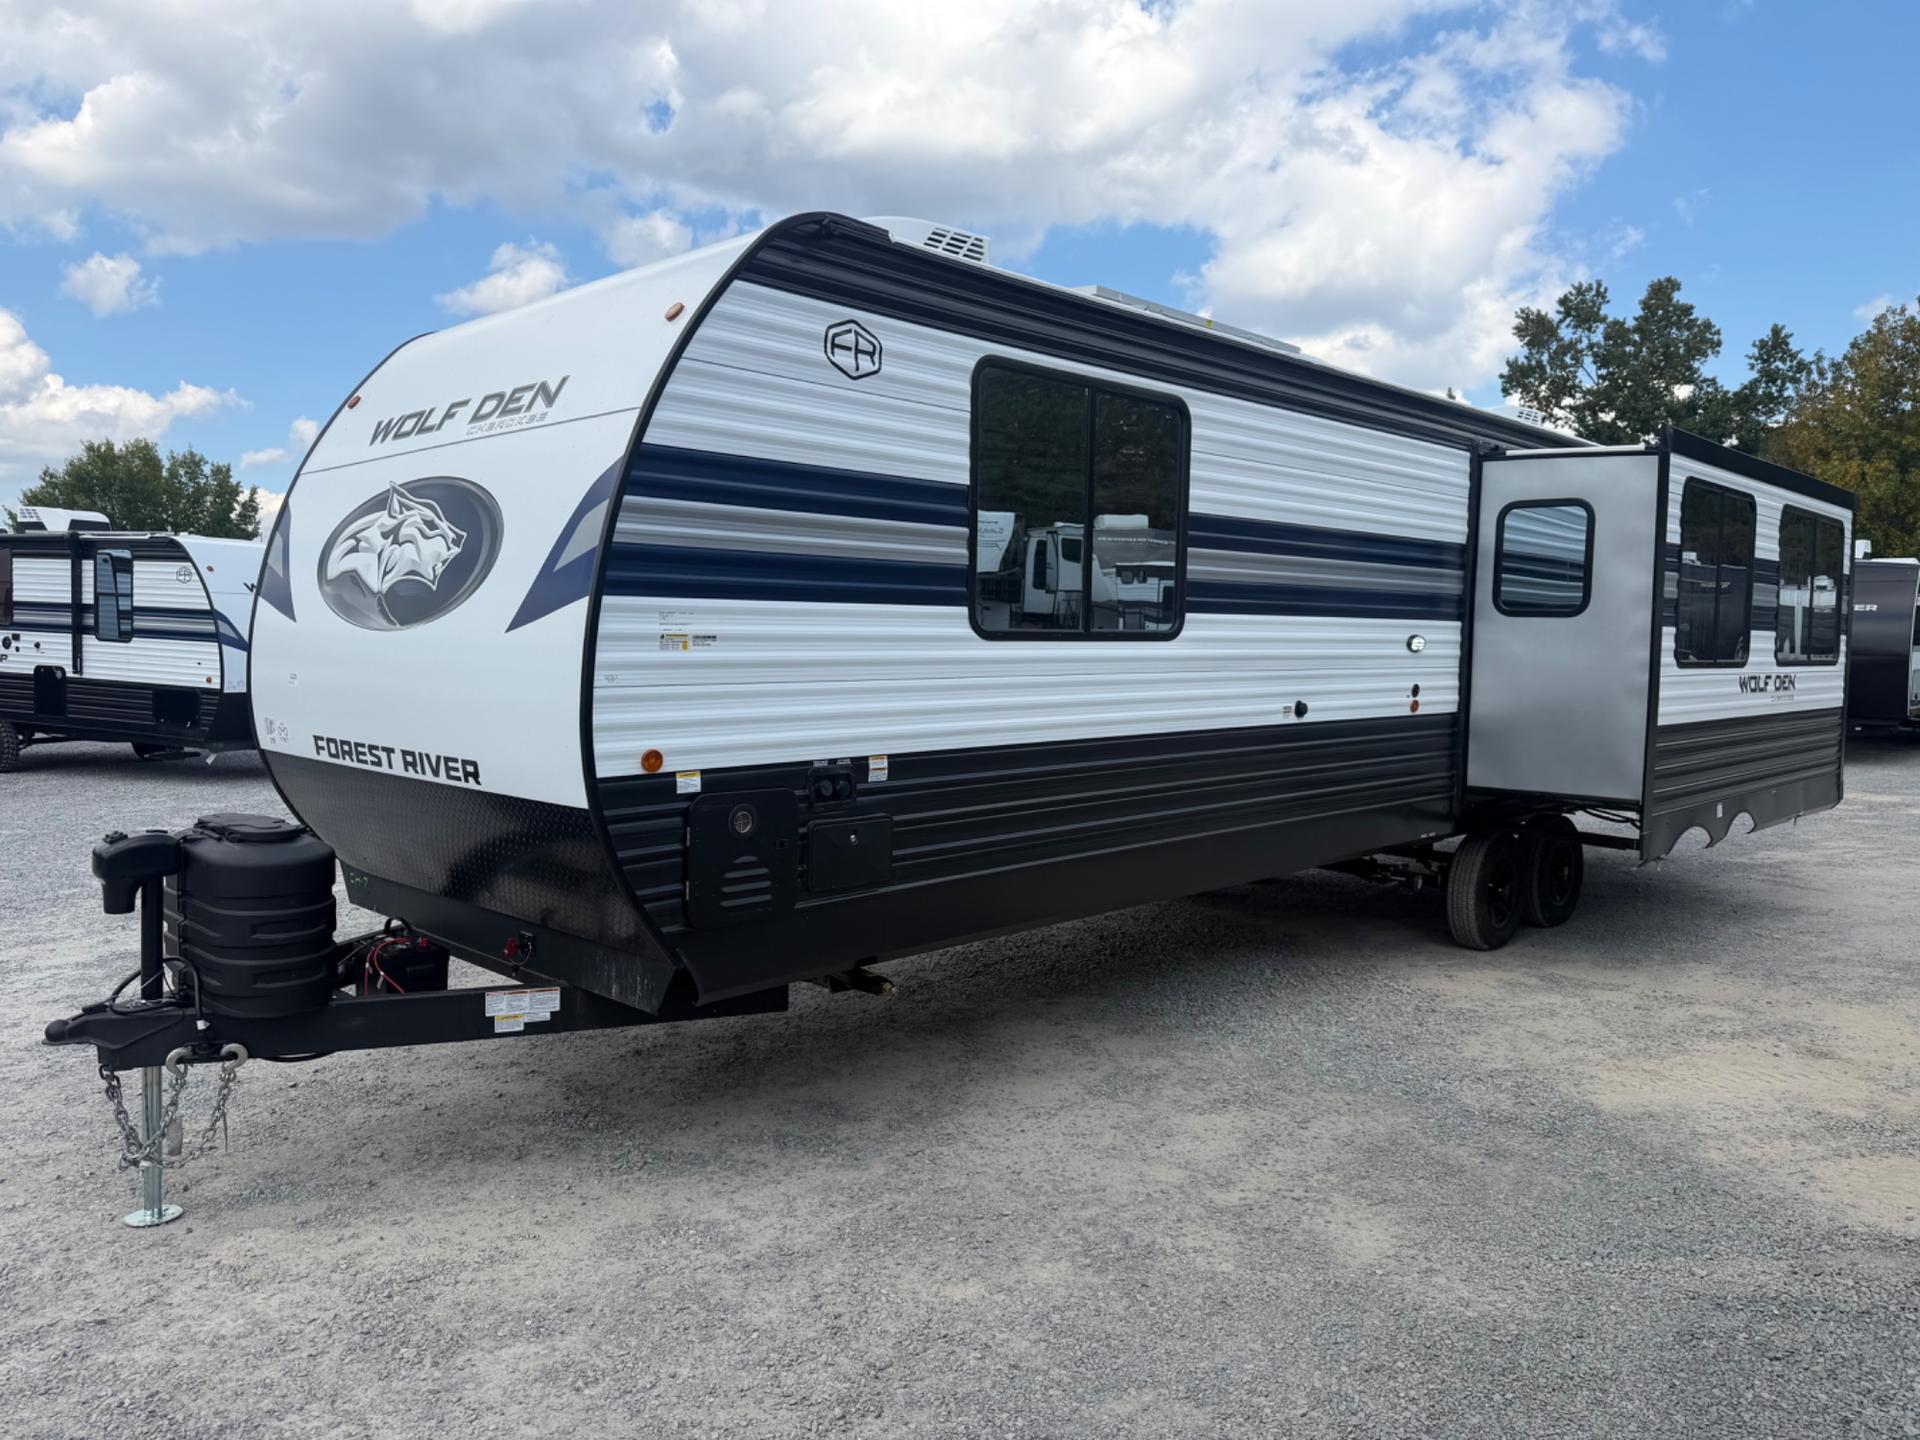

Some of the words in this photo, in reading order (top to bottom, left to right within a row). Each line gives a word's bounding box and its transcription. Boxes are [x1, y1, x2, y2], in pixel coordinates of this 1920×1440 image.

[369, 398, 472, 446] WOLF
[468, 375, 570, 425] DEN
[1739, 675, 1772, 694] WOLF
[1774, 673, 1797, 691] DEN
[313, 735, 395, 769] FOREST
[400, 749, 482, 786] RIVER
